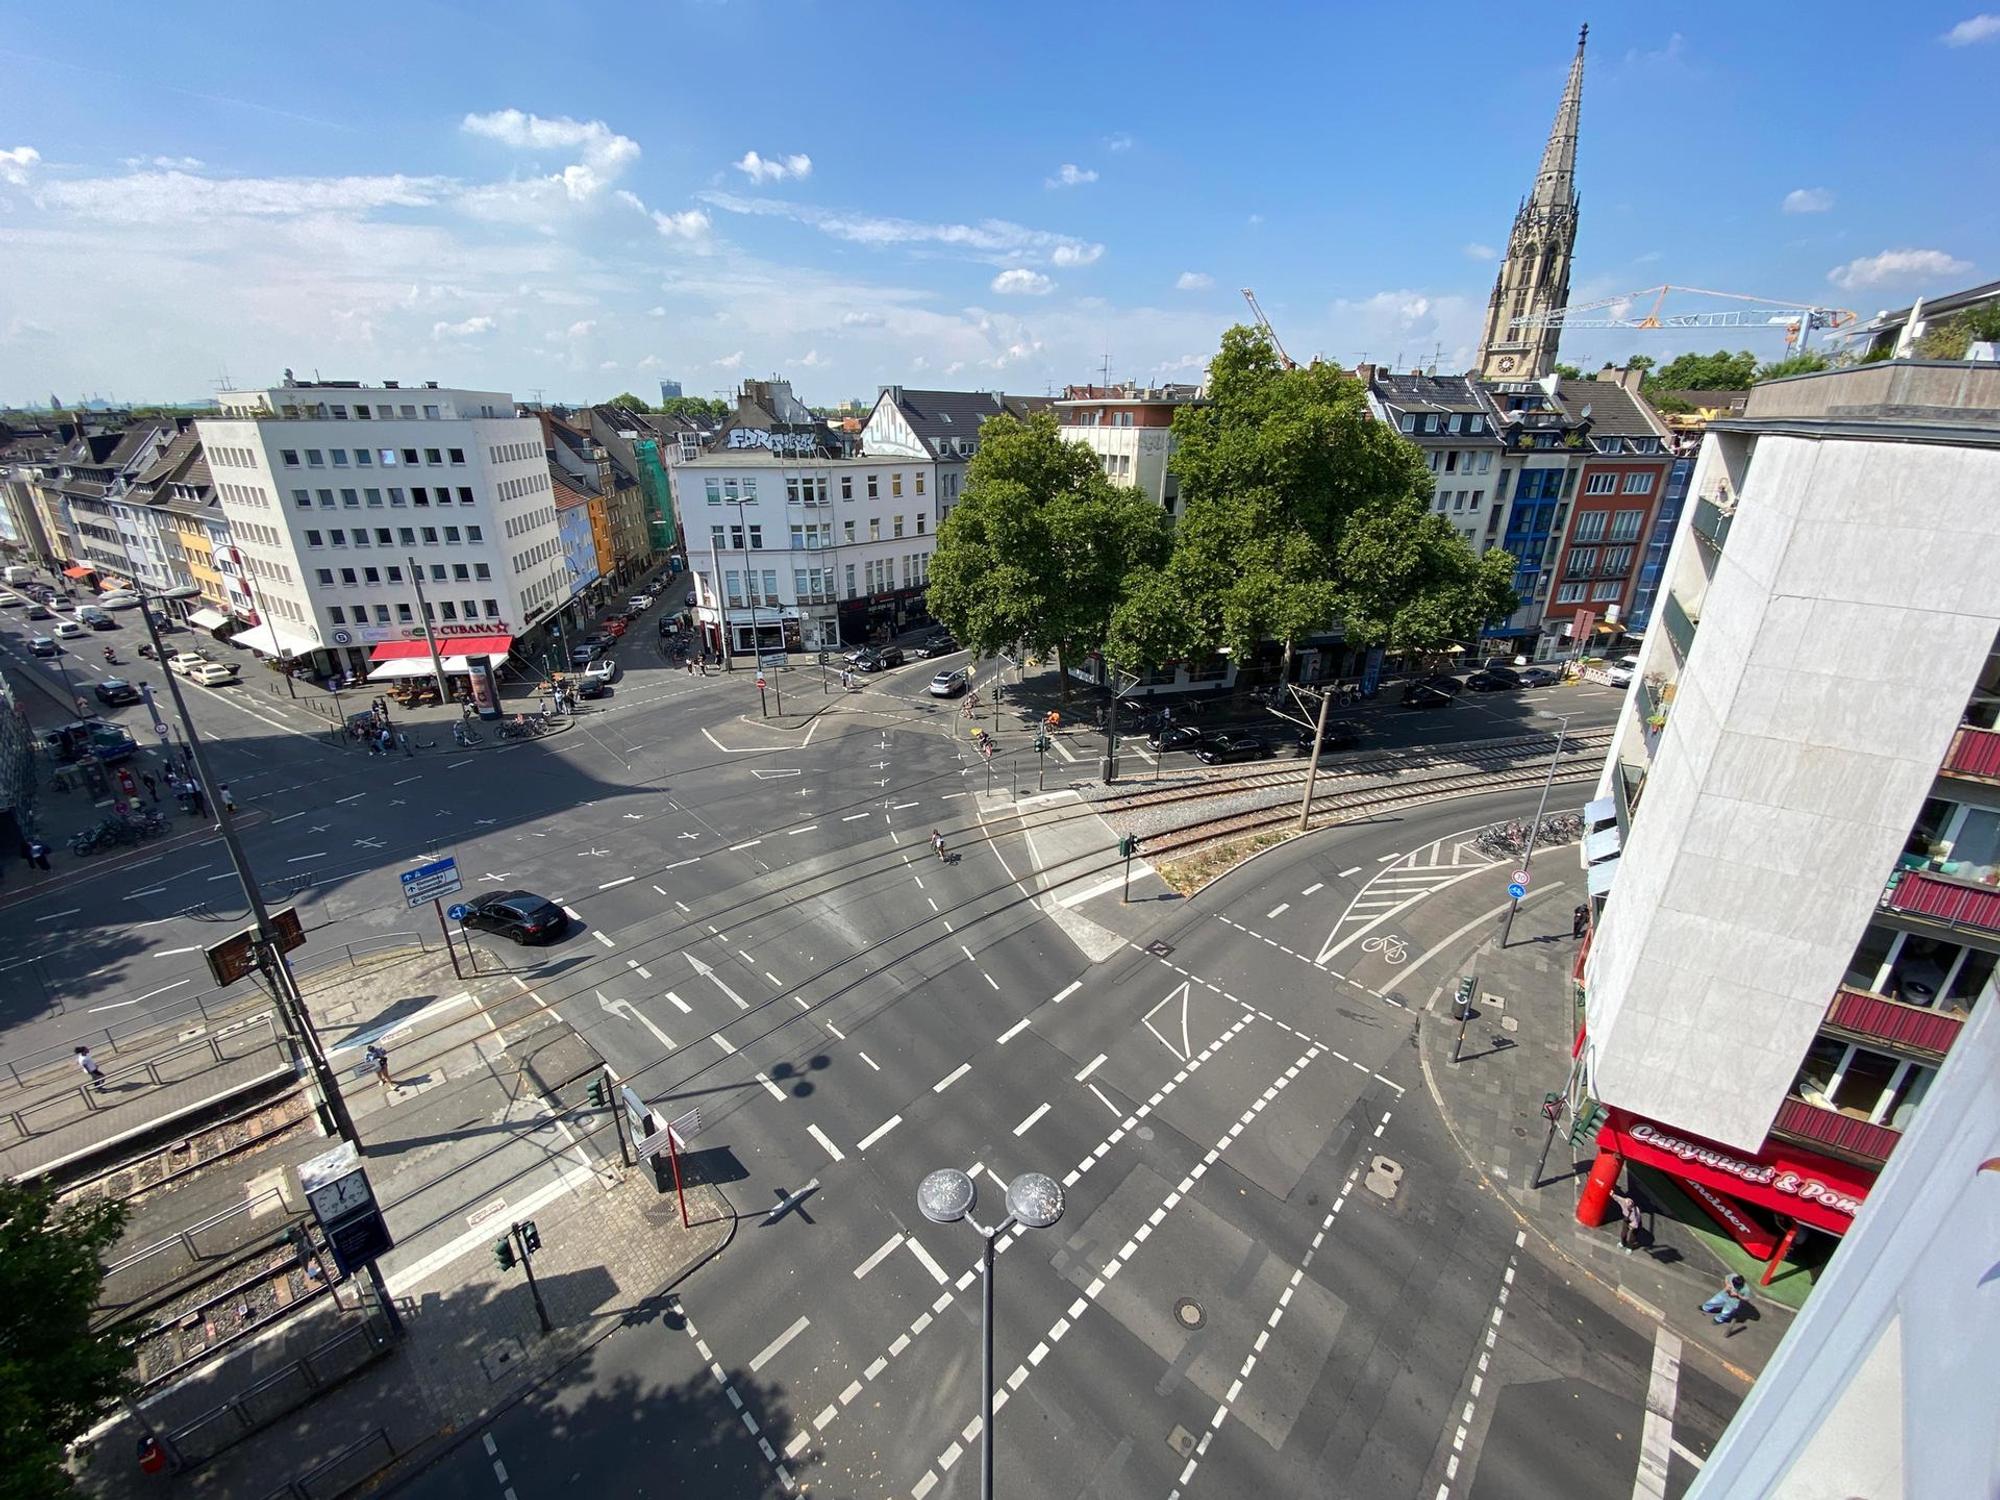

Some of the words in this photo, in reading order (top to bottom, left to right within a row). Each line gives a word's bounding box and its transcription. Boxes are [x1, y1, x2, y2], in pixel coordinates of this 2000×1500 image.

[440, 623, 494, 635] CUBANA
[1629, 1123, 1776, 1184] Currywurst
[1773, 1170, 1802, 1194] &
